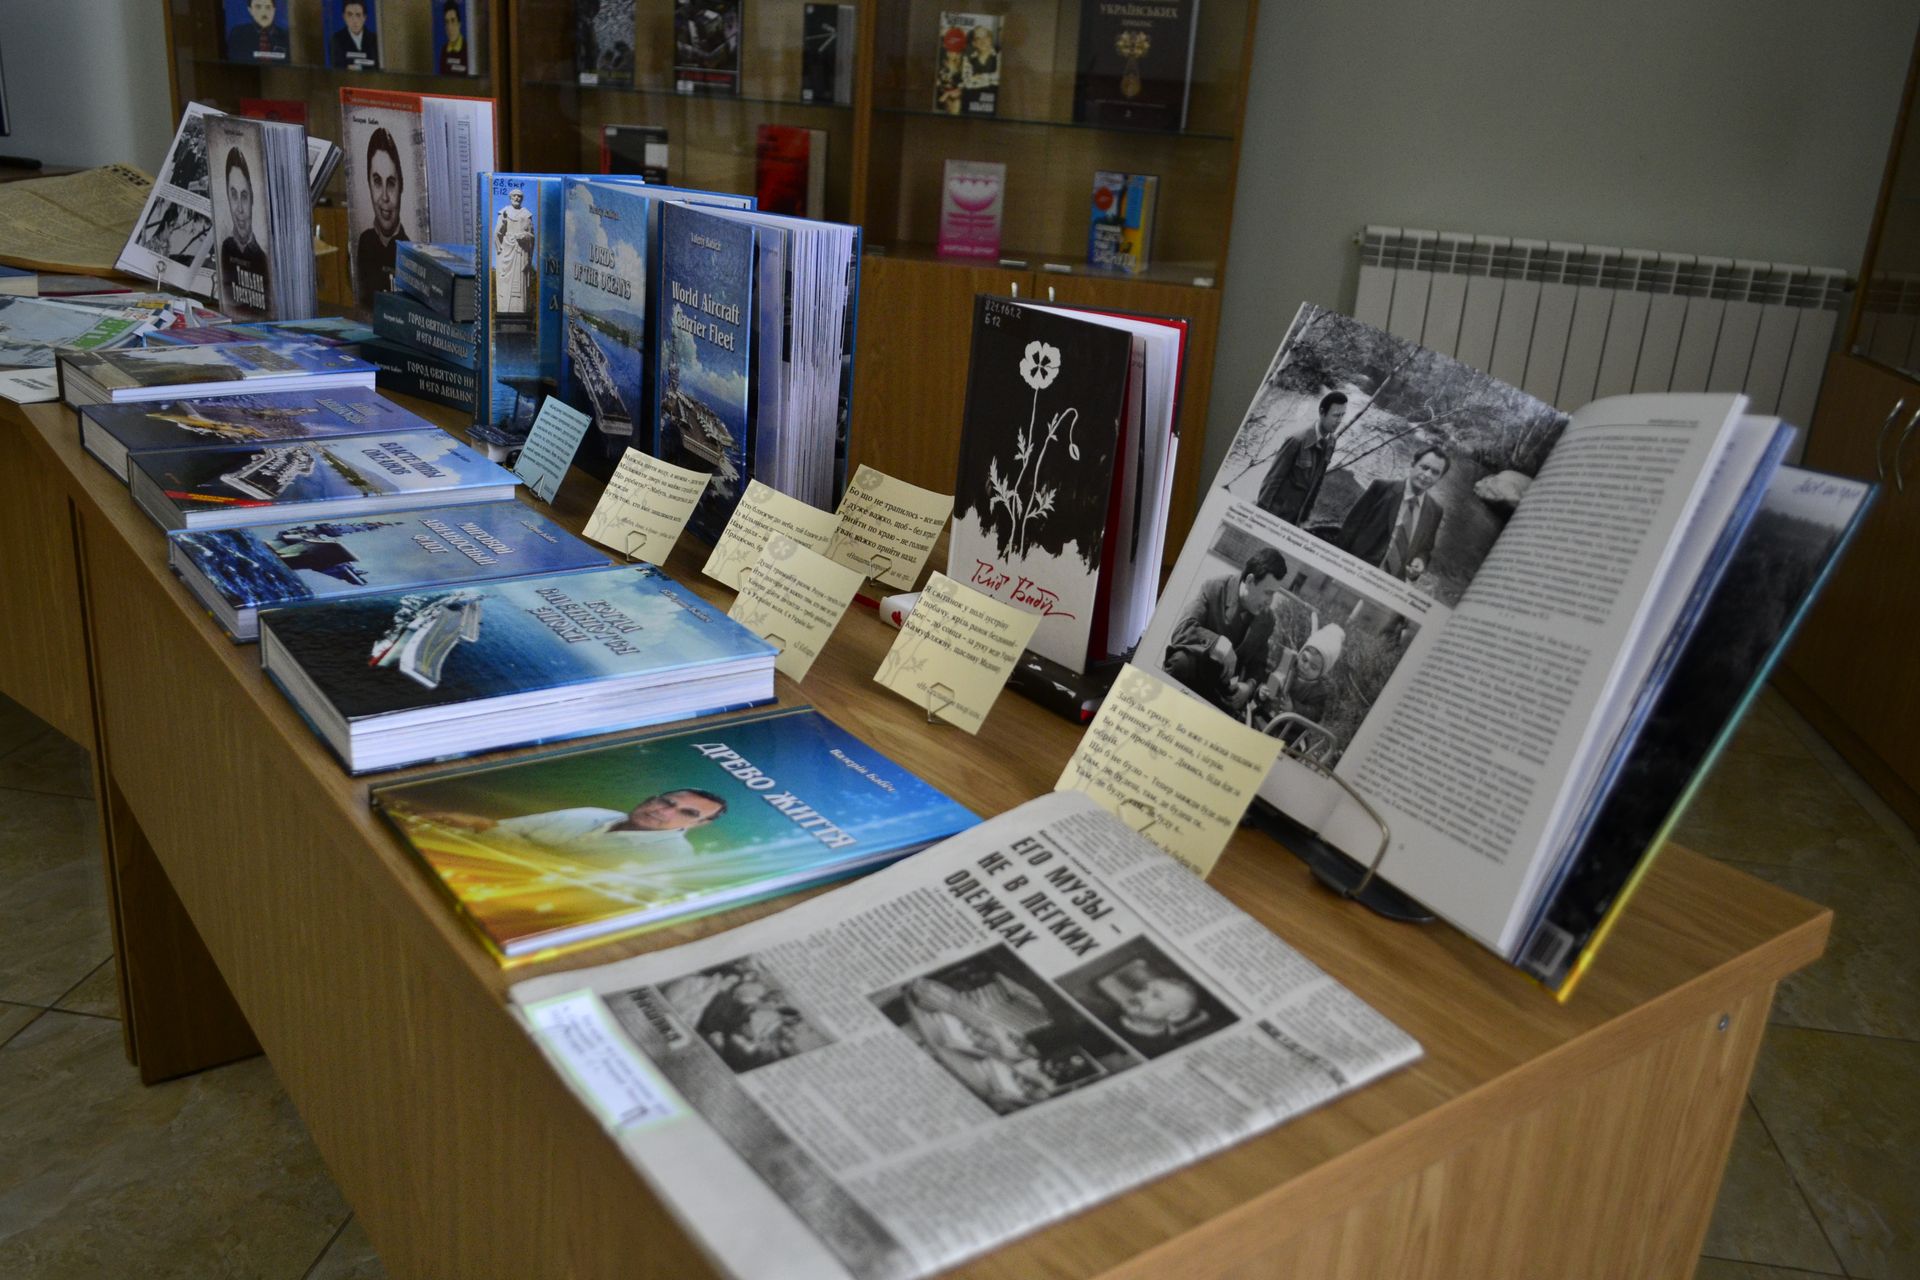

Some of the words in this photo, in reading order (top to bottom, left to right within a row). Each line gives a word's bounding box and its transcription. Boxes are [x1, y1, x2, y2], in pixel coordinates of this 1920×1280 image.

[1100, 4, 1178, 18] УКРАЇНСЬКИХ
[589, 244, 616, 269] LORDS
[574, 263, 582, 281] OF
[583, 267, 598, 288] THE
[601, 274, 632, 300] OCEANS
[672, 280, 698, 307] World
[702, 292, 740, 326] Aircraft
[408, 312, 424, 328] ГОРОД
[425, 317, 449, 336] СВЯТОГО
[416, 331, 421, 342] И
[421, 332, 432, 344] ЕГО
[676, 310, 706, 339] Carrier
[709, 322, 735, 351] Fleet
[407, 360, 429, 378] ГОРОД
[430, 365, 462, 386] СВЯТОГО
[419, 379, 425, 390] И
[426, 382, 440, 396] ЕГО
[361, 449, 413, 476] ОКЕАНОВ
[379, 442, 447, 479] ВЛАСТЕЛИНЫ
[847, 502, 868, 515] дуже
[868, 511, 893, 524] важко,
[894, 520, 908, 530] щоб
[848, 487, 860, 495] Бо
[860, 493, 873, 501] що
[883, 503, 918, 520] трапилось
[456, 522, 515, 556] МИРОВОЙ
[729, 519, 743, 529] Нам
[877, 529, 895, 541] краю
[412, 534, 449, 554] ФЛОТ
[419, 518, 500, 566] АВИАНОСНЫЙ
[834, 526, 854, 539] уває
[854, 534, 876, 546] важко
[876, 542, 901, 558] прийти
[585, 600, 643, 633] КОГДА
[911, 608, 925, 619] Бог
[922, 600, 951, 618] побачу,
[951, 616, 969, 627] крізь
[931, 590, 963, 607] світанок
[969, 608, 984, 618] полі
[526, 606, 591, 644] ЭПОХИ
[1103, 717, 1114, 726] Бо
[1115, 725, 1128, 734] все
[1116, 691, 1147, 712] Забудь
[1176, 723, 1187, 733] Бо
[1117, 710, 1152, 732] принесу
[1082, 754, 1100, 768] Там,
[1113, 772, 1142, 793] будеш,
[1088, 741, 1103, 753] Що
[1111, 755, 1121, 763] не
[1122, 760, 1142, 776] було
[1150, 776, 1174, 794] Тепер
[690, 742, 776, 790] ДРЕВО
[762, 790, 857, 850] ЖИТТЯ
[1009, 836, 1053, 866] ЕГО
[1044, 865, 1114, 921] МУЗЫ
[944, 869, 1038, 949] ОДЕЖДАХ
[977, 851, 1013, 876] НЕ
[1003, 874, 1030, 892] В
[1019, 891, 1101, 957] ЛЕГКИХ
